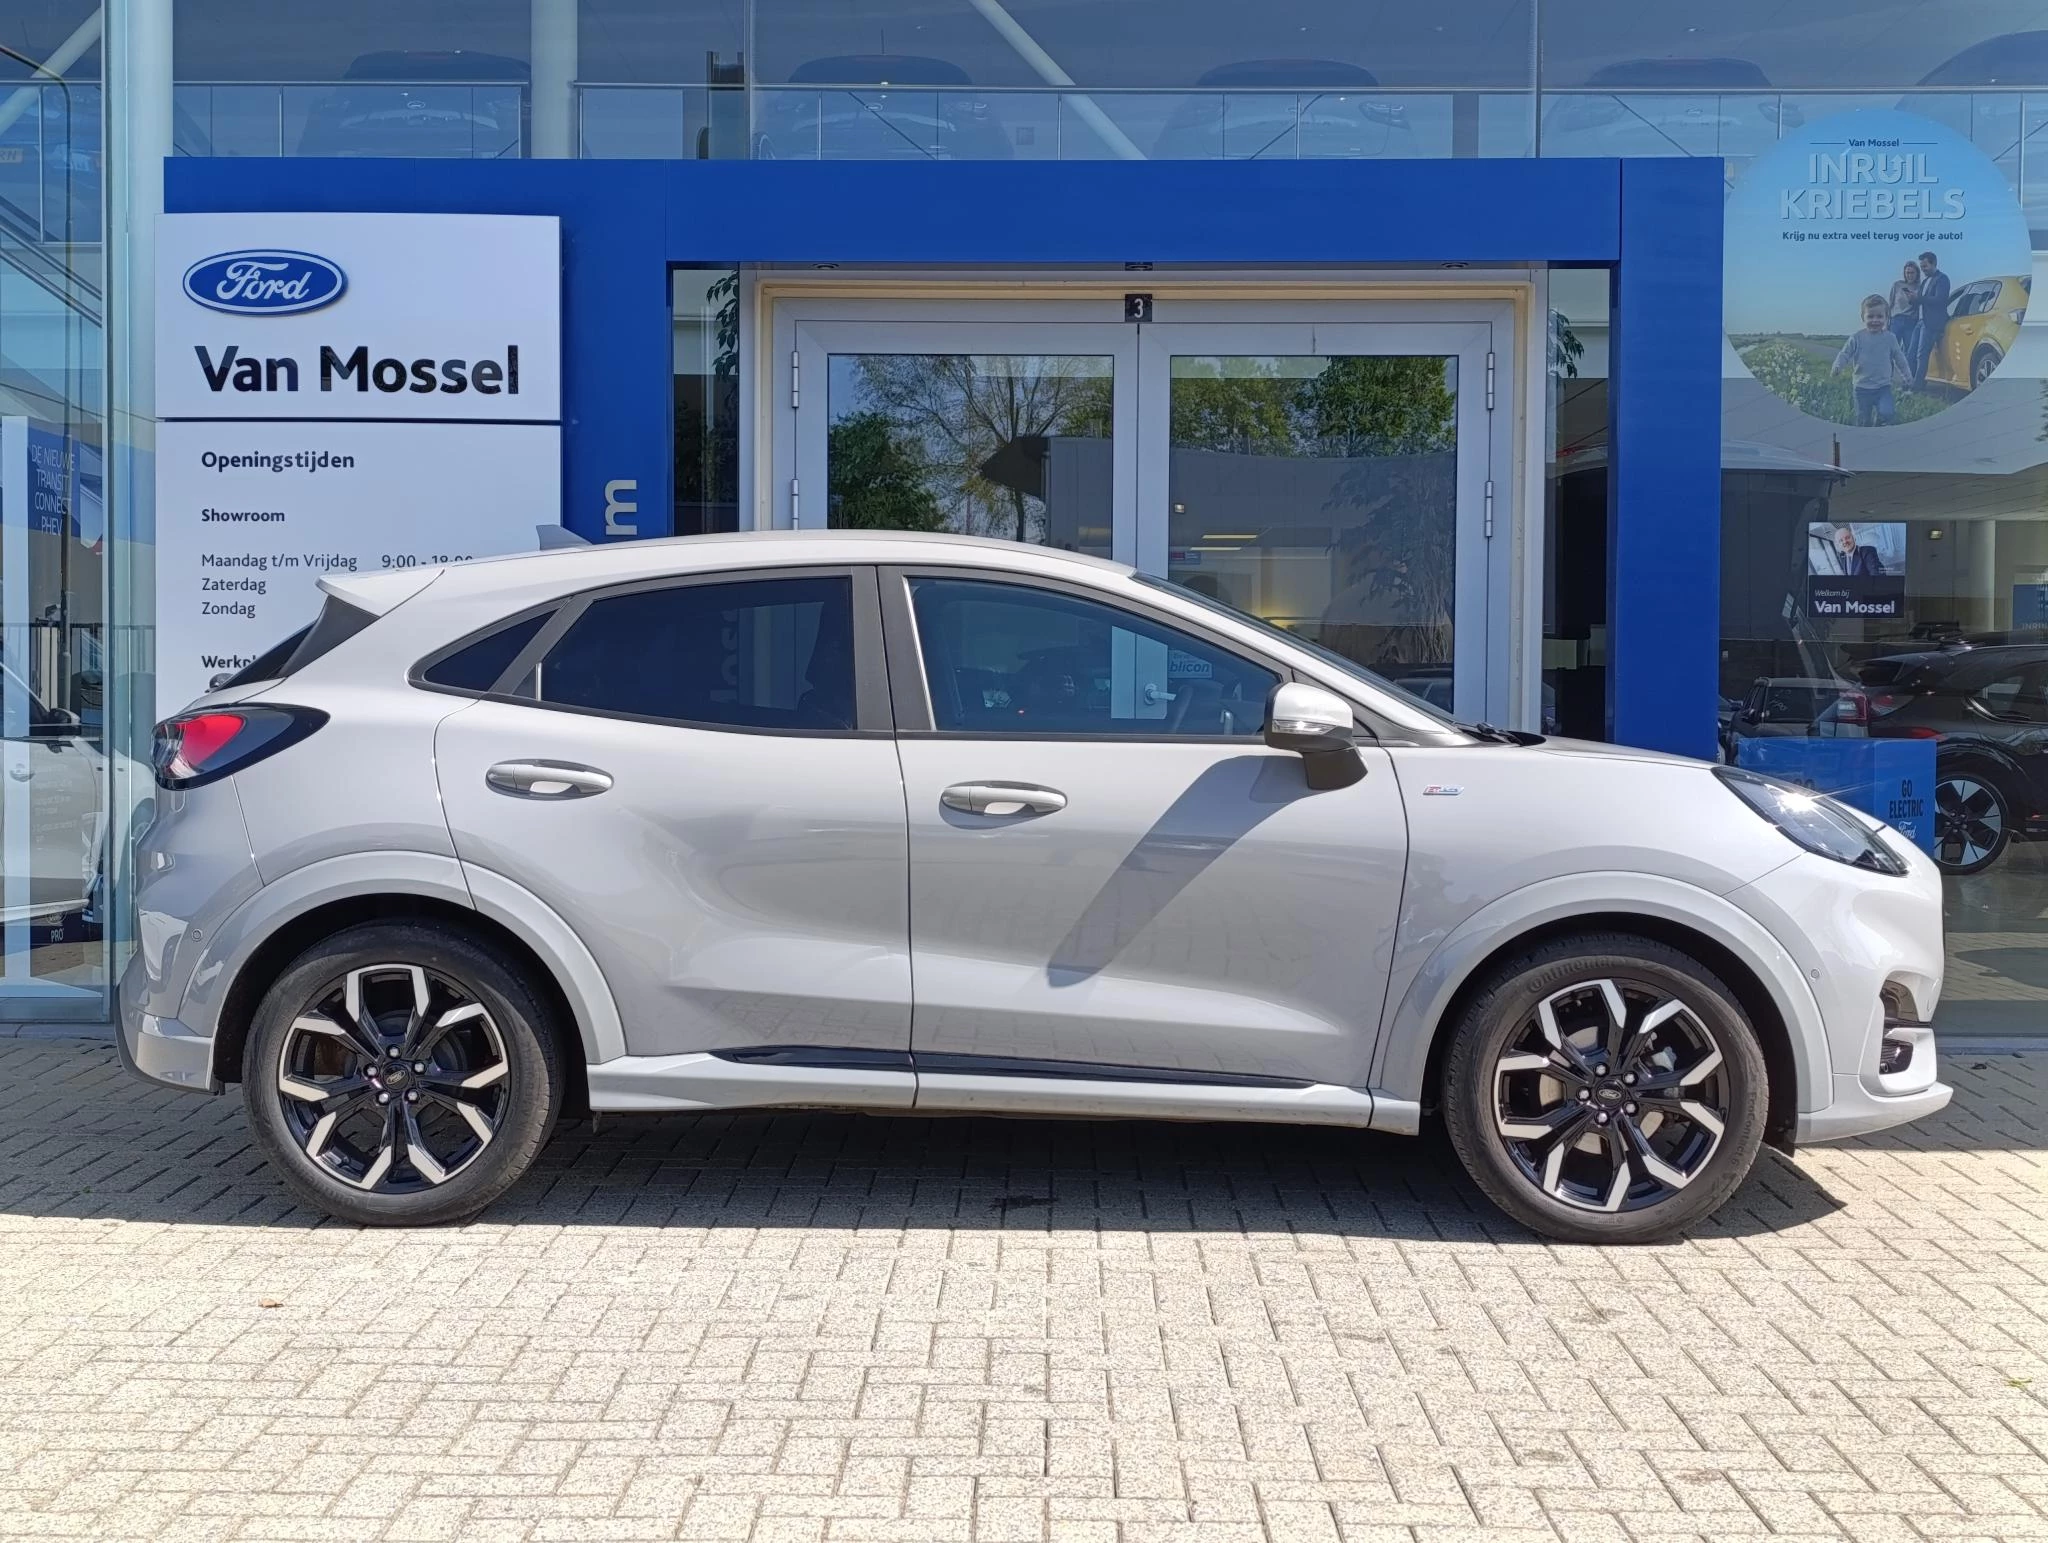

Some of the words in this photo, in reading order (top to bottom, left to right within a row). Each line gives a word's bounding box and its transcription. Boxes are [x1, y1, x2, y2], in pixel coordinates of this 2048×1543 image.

[1848, 138, 1866, 148] Van
[1868, 138, 1900, 148] Mossel
[1808, 151, 1940, 184] INRUIL
[1780, 188, 1967, 220] KRIEBELS
[1782, 231, 1805, 242] Krijg
[1808, 232, 1820, 241] nu
[1822, 232, 1848, 241] extra
[1850, 230, 1871, 241] veel
[1873, 231, 1900, 242] terug
[1902, 232, 1924, 241] voor
[1925, 231, 1936, 242] je
[1938, 231, 1964, 241] auto!
[216, 260, 313, 301] Ford
[1134, 298, 1144, 318] 3
[194, 345, 300, 393] Van
[319, 344, 520, 395] Mossel
[201, 451, 355, 473] Openingstijden
[201, 508, 286, 523] Showroom
[201, 553, 267, 571] Maandag
[271, 553, 299, 569] t/m
[303, 553, 358, 572] Vrijdag
[381, 554, 416, 569] 9:00
[201, 577, 267, 596] Zaterdag
[201, 601, 257, 619] Zondag
[1815, 600, 1842, 615] Van
[1845, 600, 1896, 614] Mossel
[1901, 779, 1913, 798] GO
[1889, 800, 1925, 819] ELECTRIC
